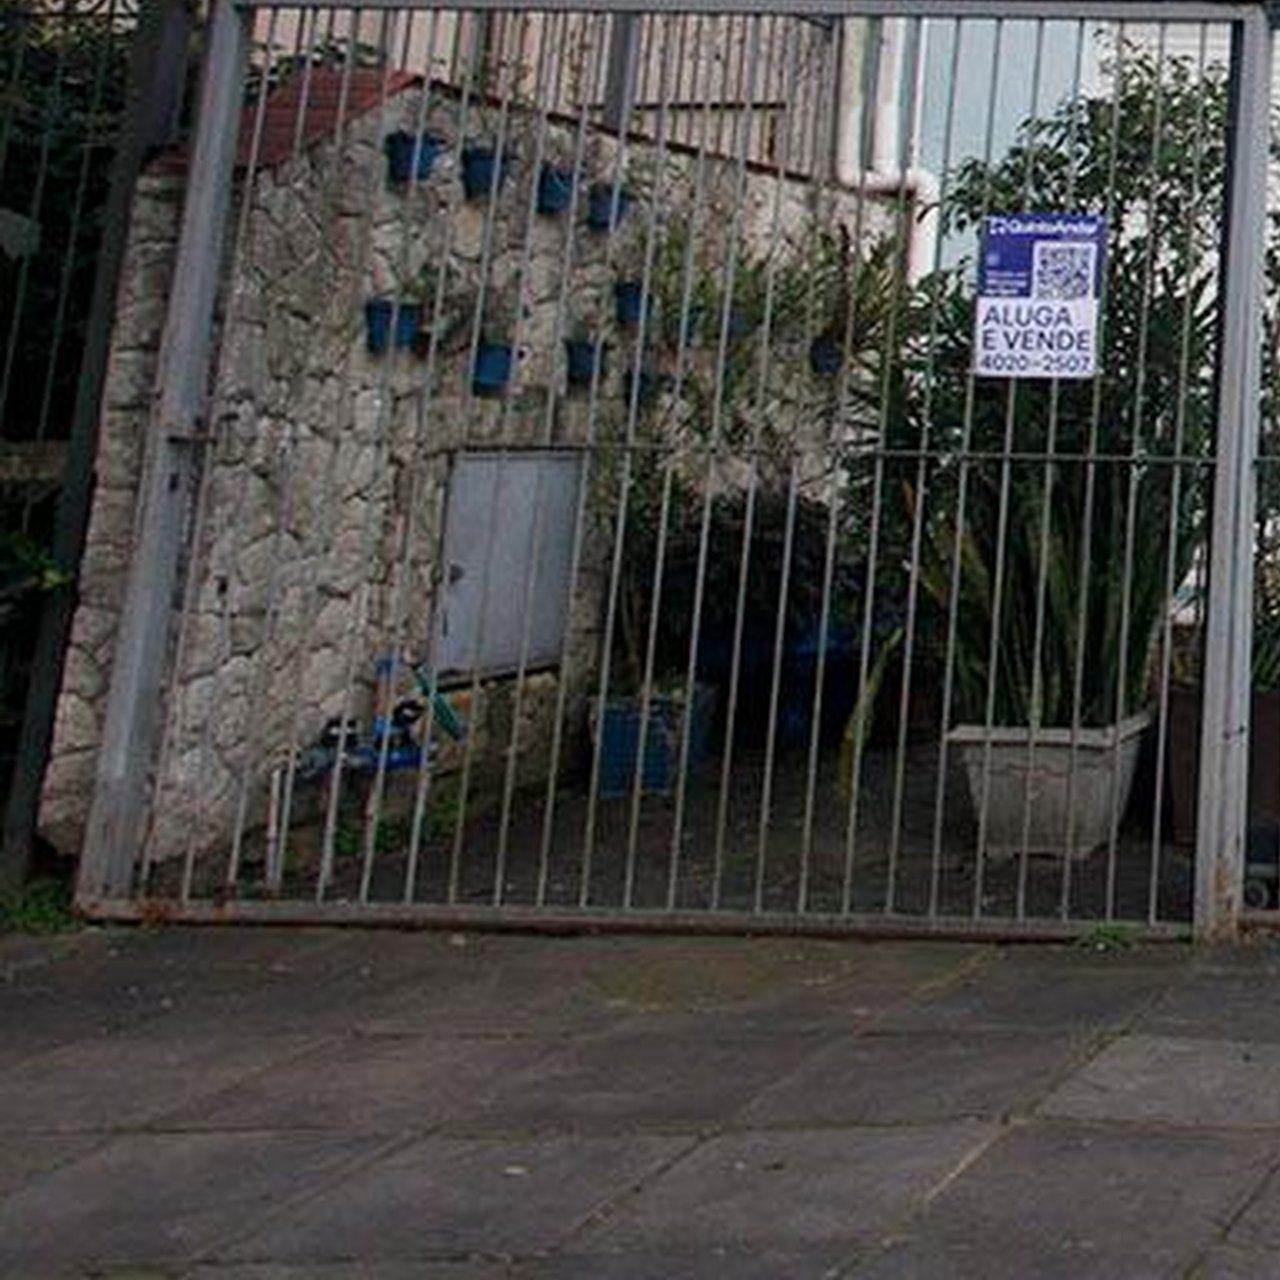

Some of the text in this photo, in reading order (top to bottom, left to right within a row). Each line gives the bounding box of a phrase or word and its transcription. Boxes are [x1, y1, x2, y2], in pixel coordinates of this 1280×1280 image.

[983, 306, 1073, 327] ALUGA
[983, 329, 1091, 351] E VENDE
